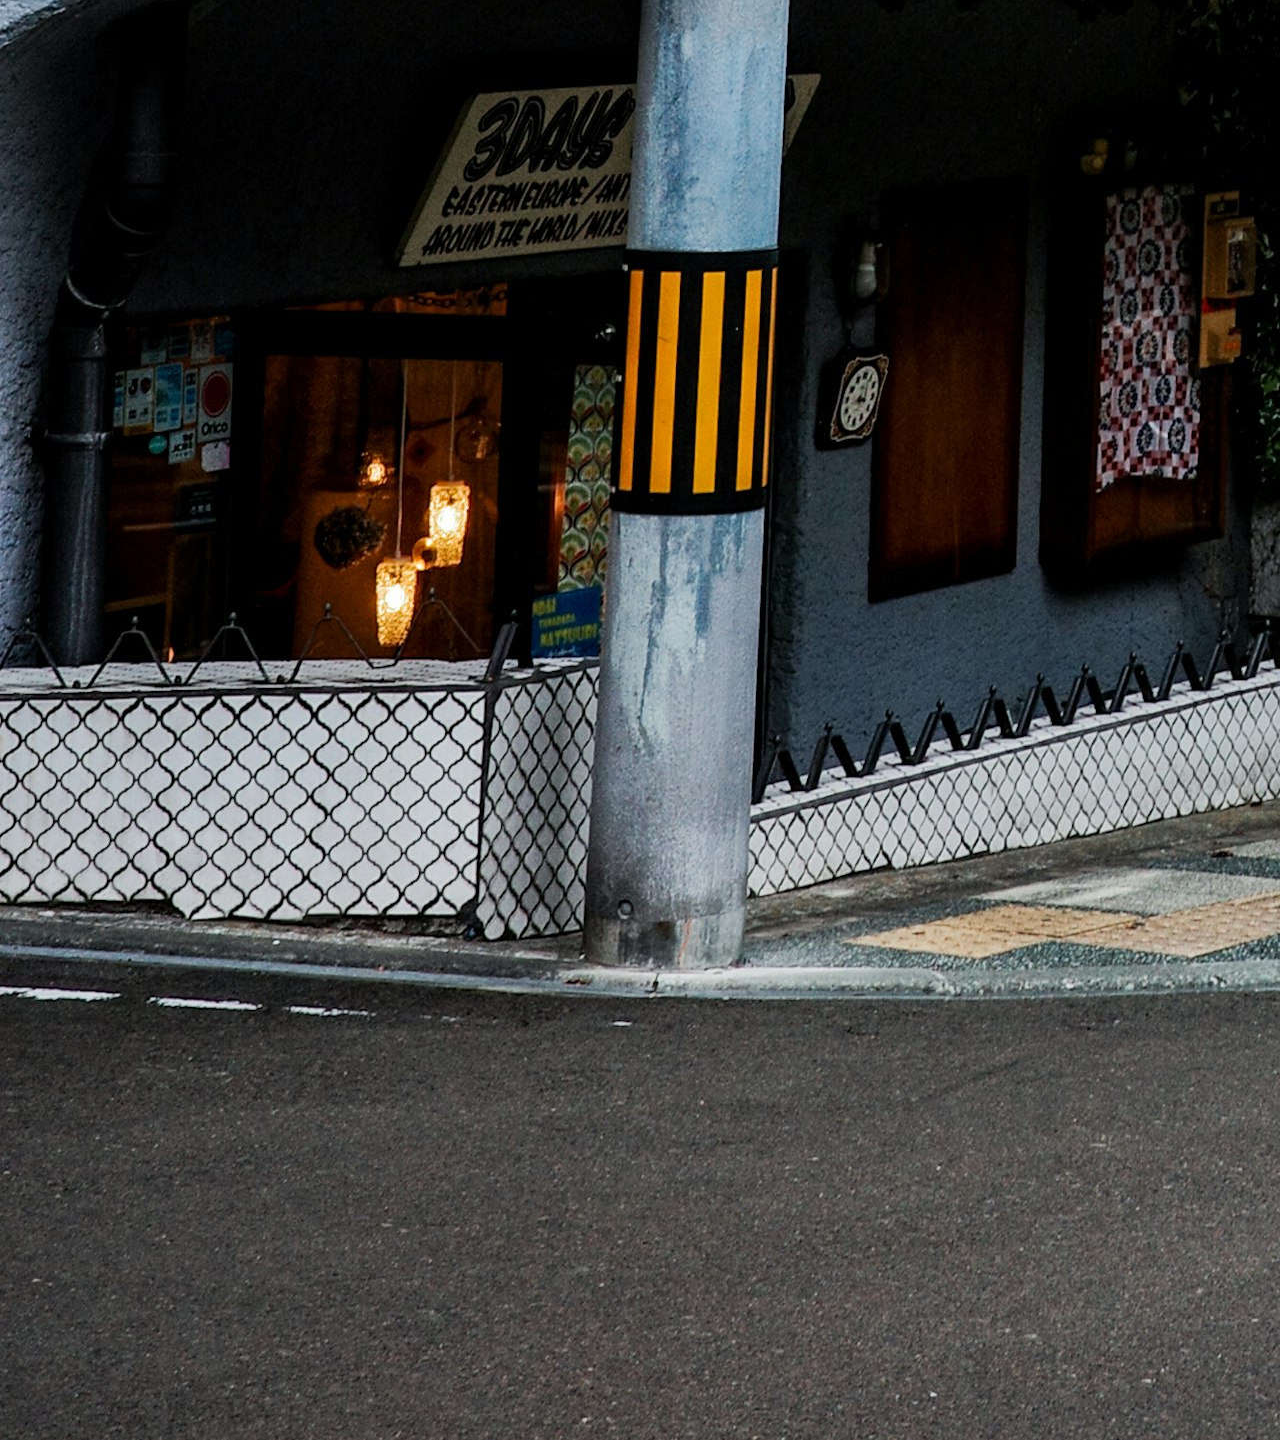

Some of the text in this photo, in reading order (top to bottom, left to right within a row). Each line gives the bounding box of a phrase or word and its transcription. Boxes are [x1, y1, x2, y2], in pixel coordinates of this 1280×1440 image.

[464, 87, 636, 182] 3DAYS
[521, 173, 632, 210] EUROPE/ANT
[422, 221, 497, 256] AROUND
[495, 217, 530, 248] THE
[201, 422, 228, 436] Orico
